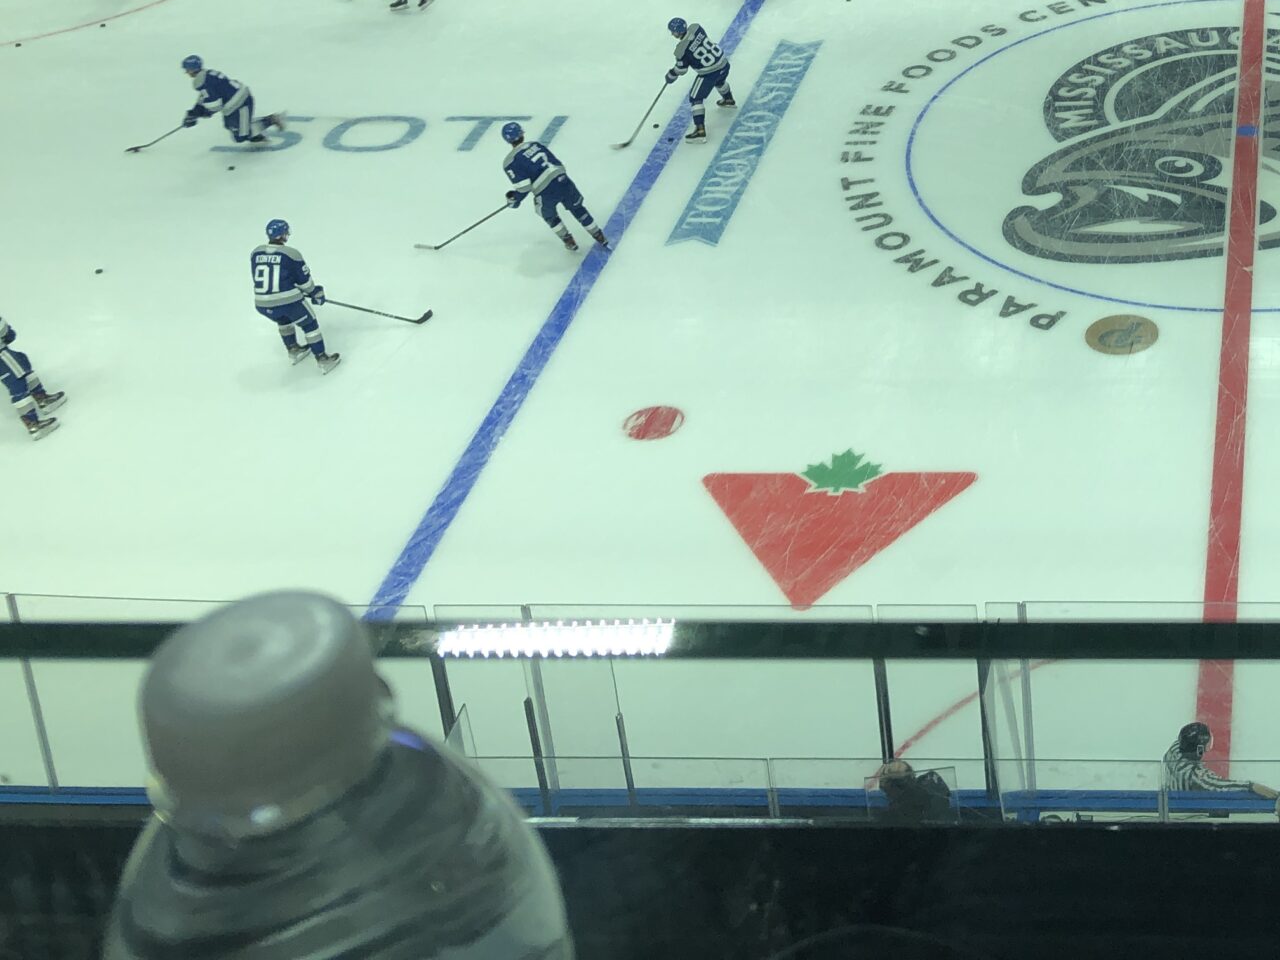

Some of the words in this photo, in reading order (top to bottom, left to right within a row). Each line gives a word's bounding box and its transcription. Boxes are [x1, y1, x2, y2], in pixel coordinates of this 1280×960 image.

[692, 37, 723, 67] 88
[885, 23, 1010, 94] FOODS
[681, 110, 781, 230] TORONTO
[752, 51, 816, 104] STAR
[840, 105, 895, 165] FINE
[254, 264, 281, 294] 91
[841, 176, 1069, 331] PARAMOUNT
